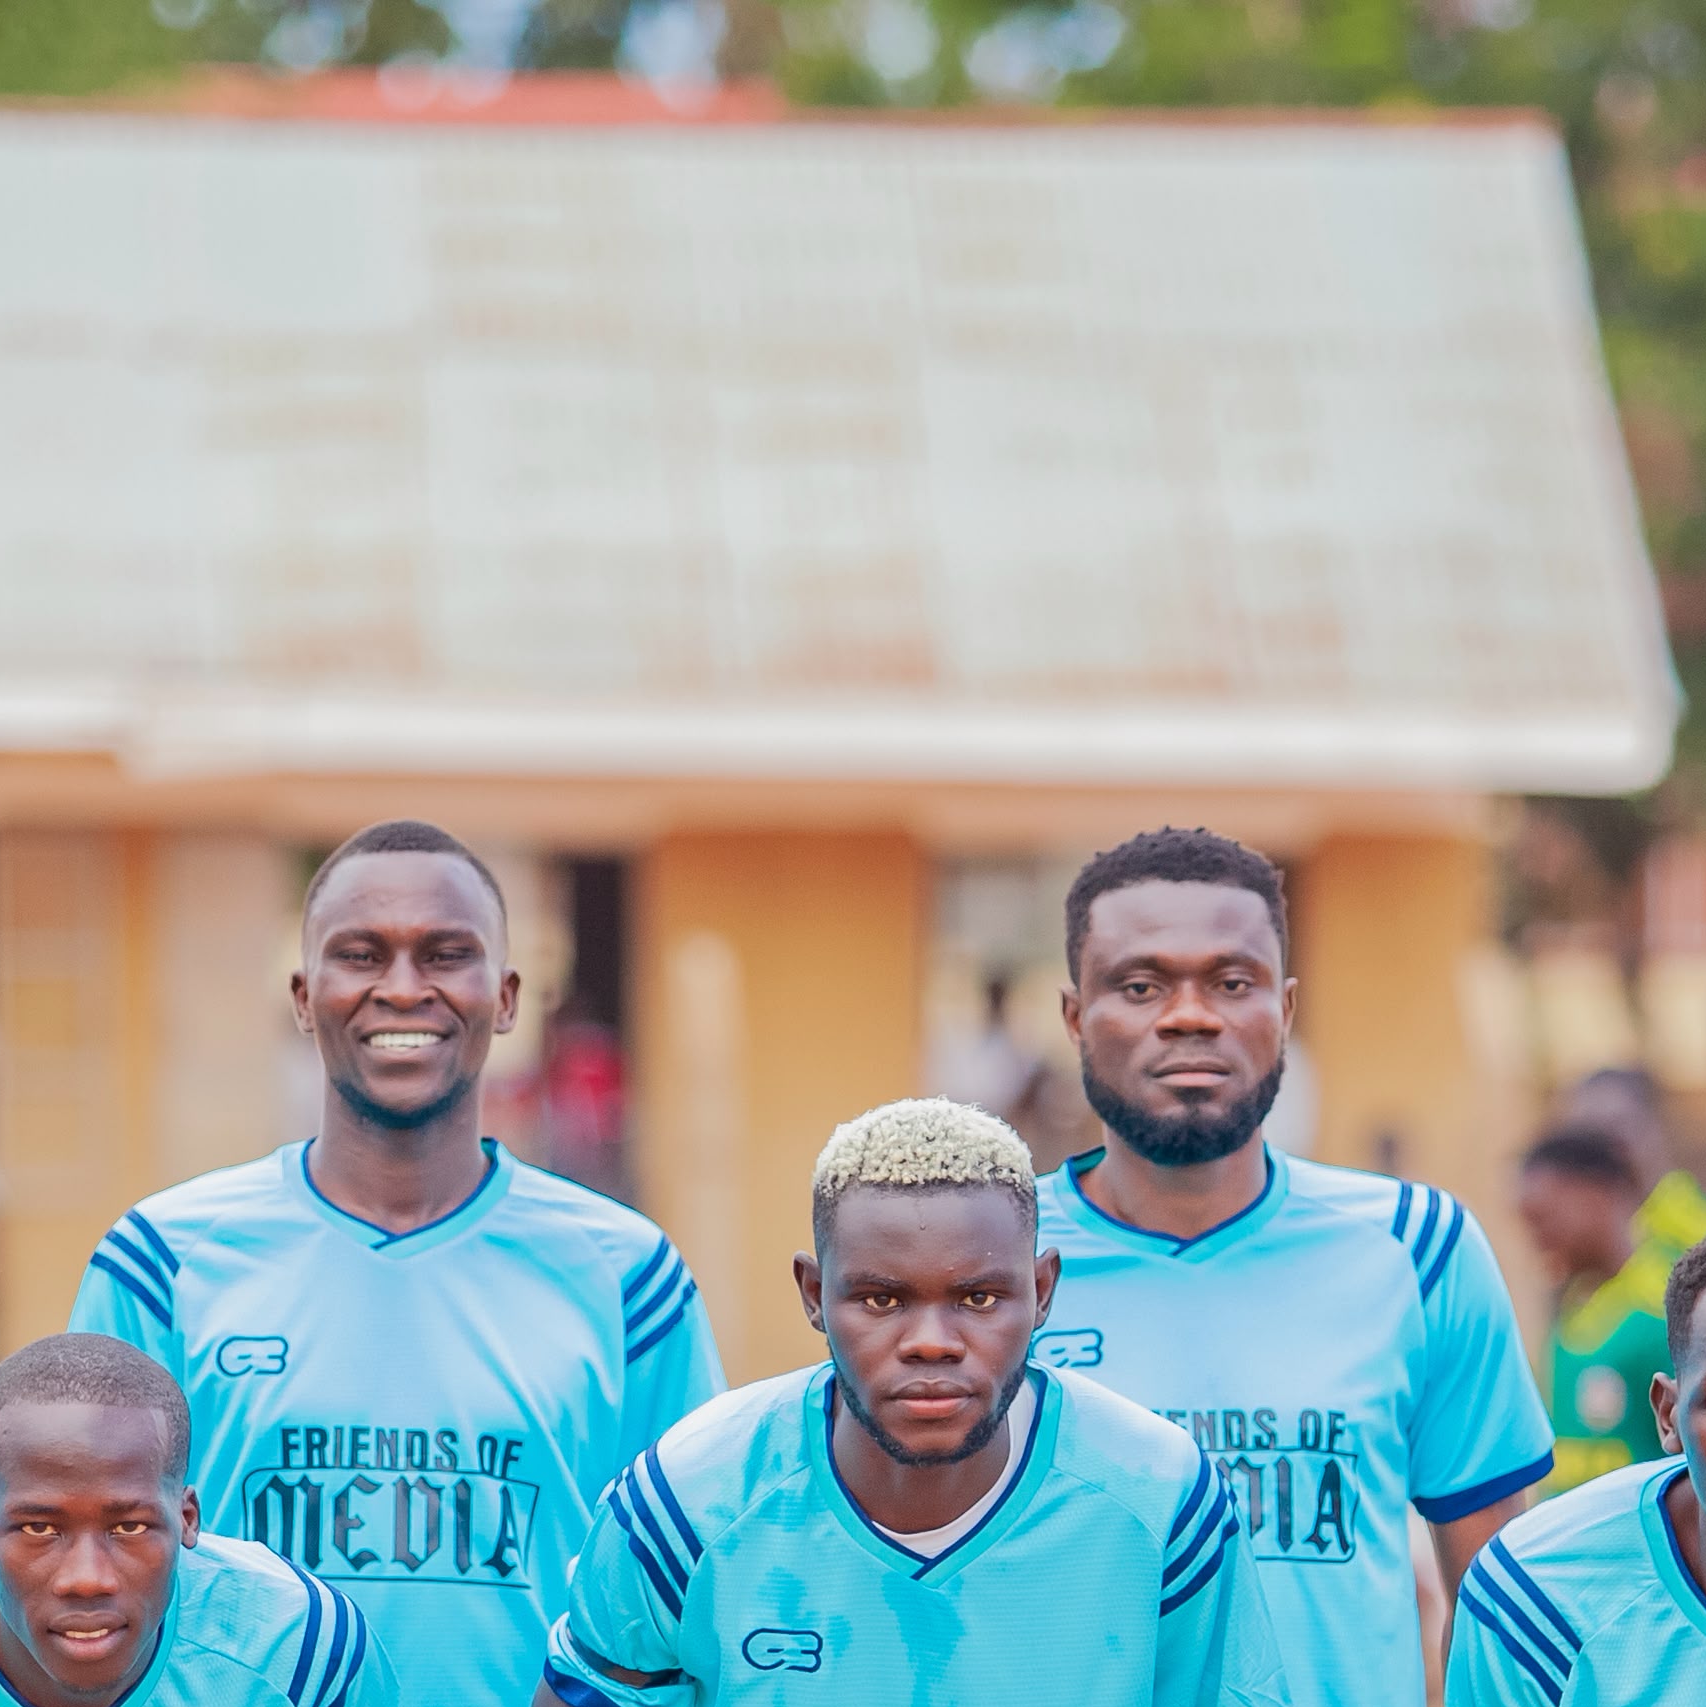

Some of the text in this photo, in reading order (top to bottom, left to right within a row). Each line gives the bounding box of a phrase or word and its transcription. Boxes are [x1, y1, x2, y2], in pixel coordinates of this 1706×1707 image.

[279, 1425, 523, 1480] FRIENDS OF
[1299, 1409, 1346, 1453] OF
[253, 1473, 526, 1578] MEDIA
